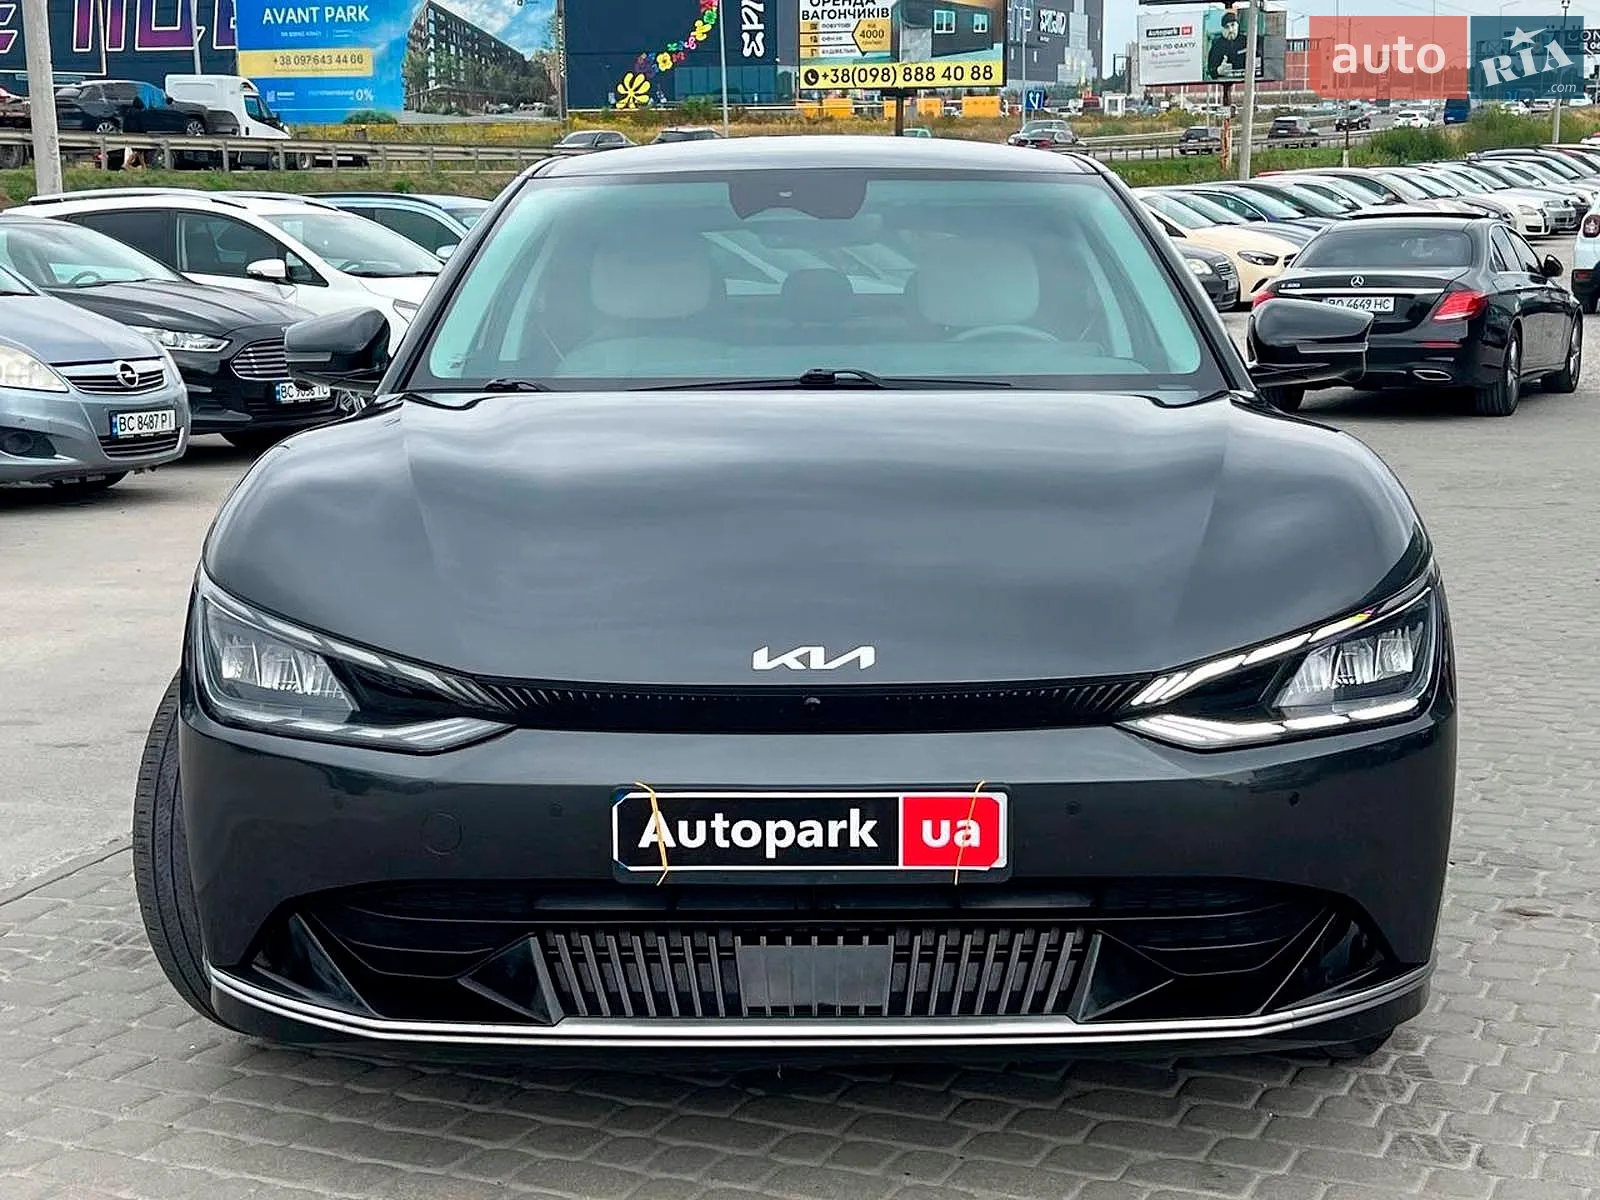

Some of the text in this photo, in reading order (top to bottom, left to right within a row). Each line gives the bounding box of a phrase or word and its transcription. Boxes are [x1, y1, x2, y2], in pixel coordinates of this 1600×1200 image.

[262, 5, 371, 25] AVANT PARK
[801, 7, 890, 20] ВАГОНЧИКІВ
[859, 29, 885, 39] 4000
[821, 64, 994, 86] +38(098) 888 40 88
[1374, 298, 1390, 310] HC
[119, 415, 135, 432] BC
[137, 413, 159, 431] 8487
[637, 807, 981, 859] Autopark ua
